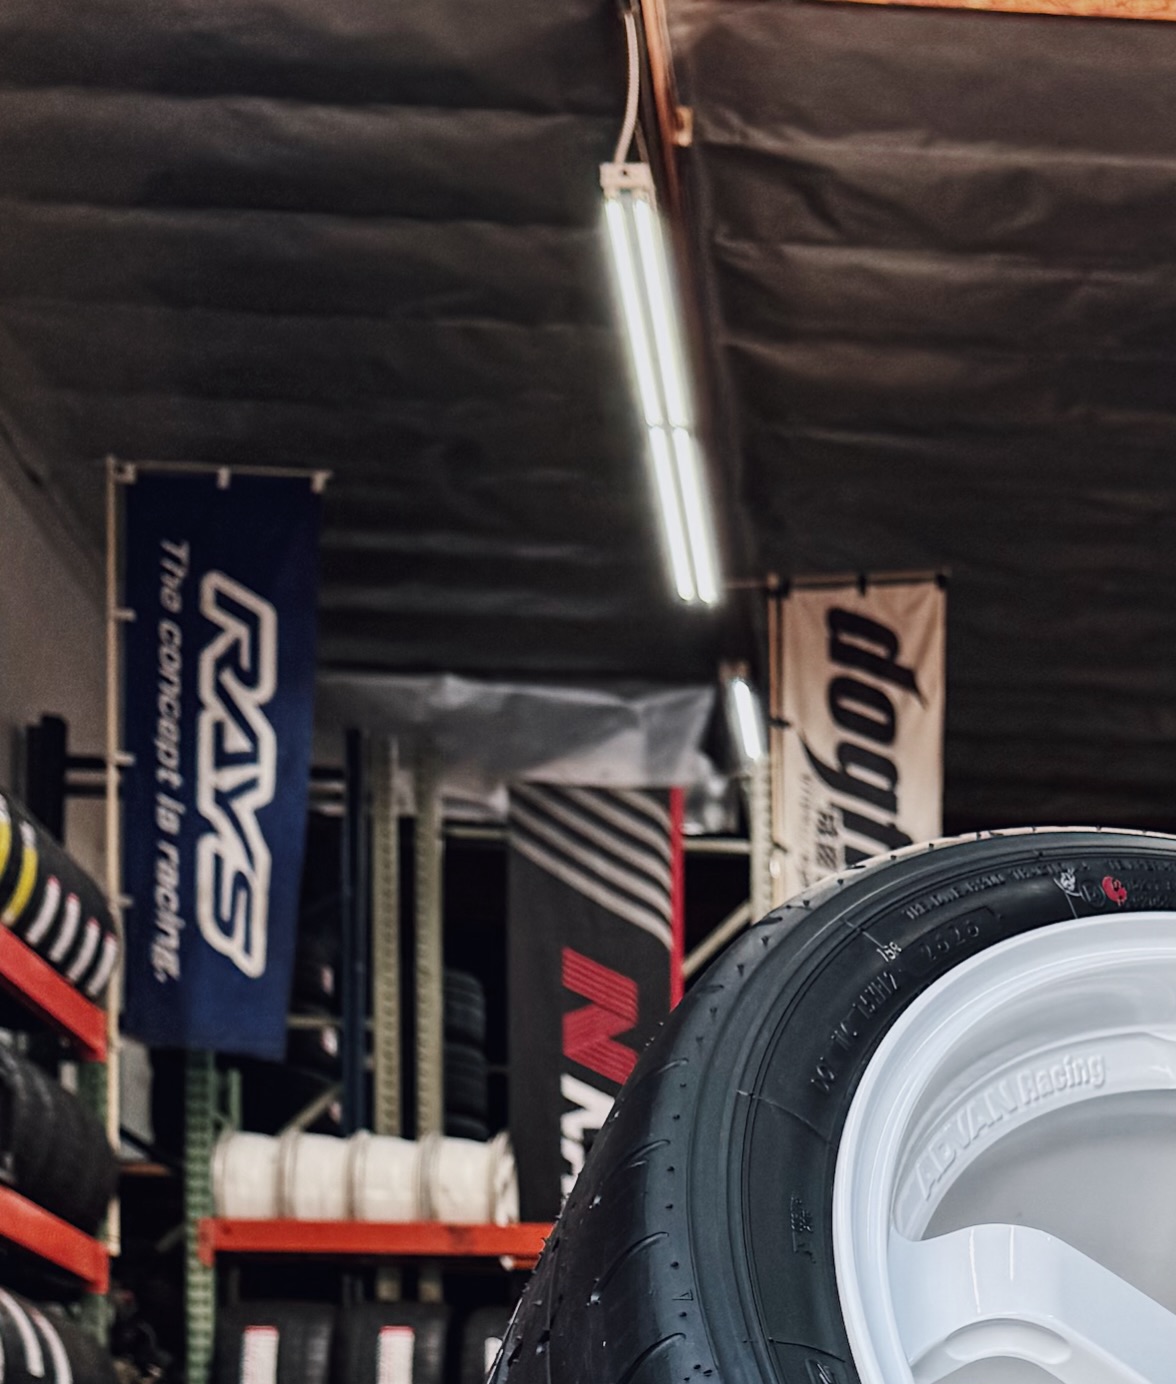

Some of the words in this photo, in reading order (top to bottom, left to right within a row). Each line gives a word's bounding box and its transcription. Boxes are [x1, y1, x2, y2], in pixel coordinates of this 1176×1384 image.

[158, 538, 190, 612] The
[152, 618, 186, 785] concept
[153, 791, 187, 830] is
[199, 569, 278, 979] RAYS
[1016, 1055, 1106, 1107] Racing
